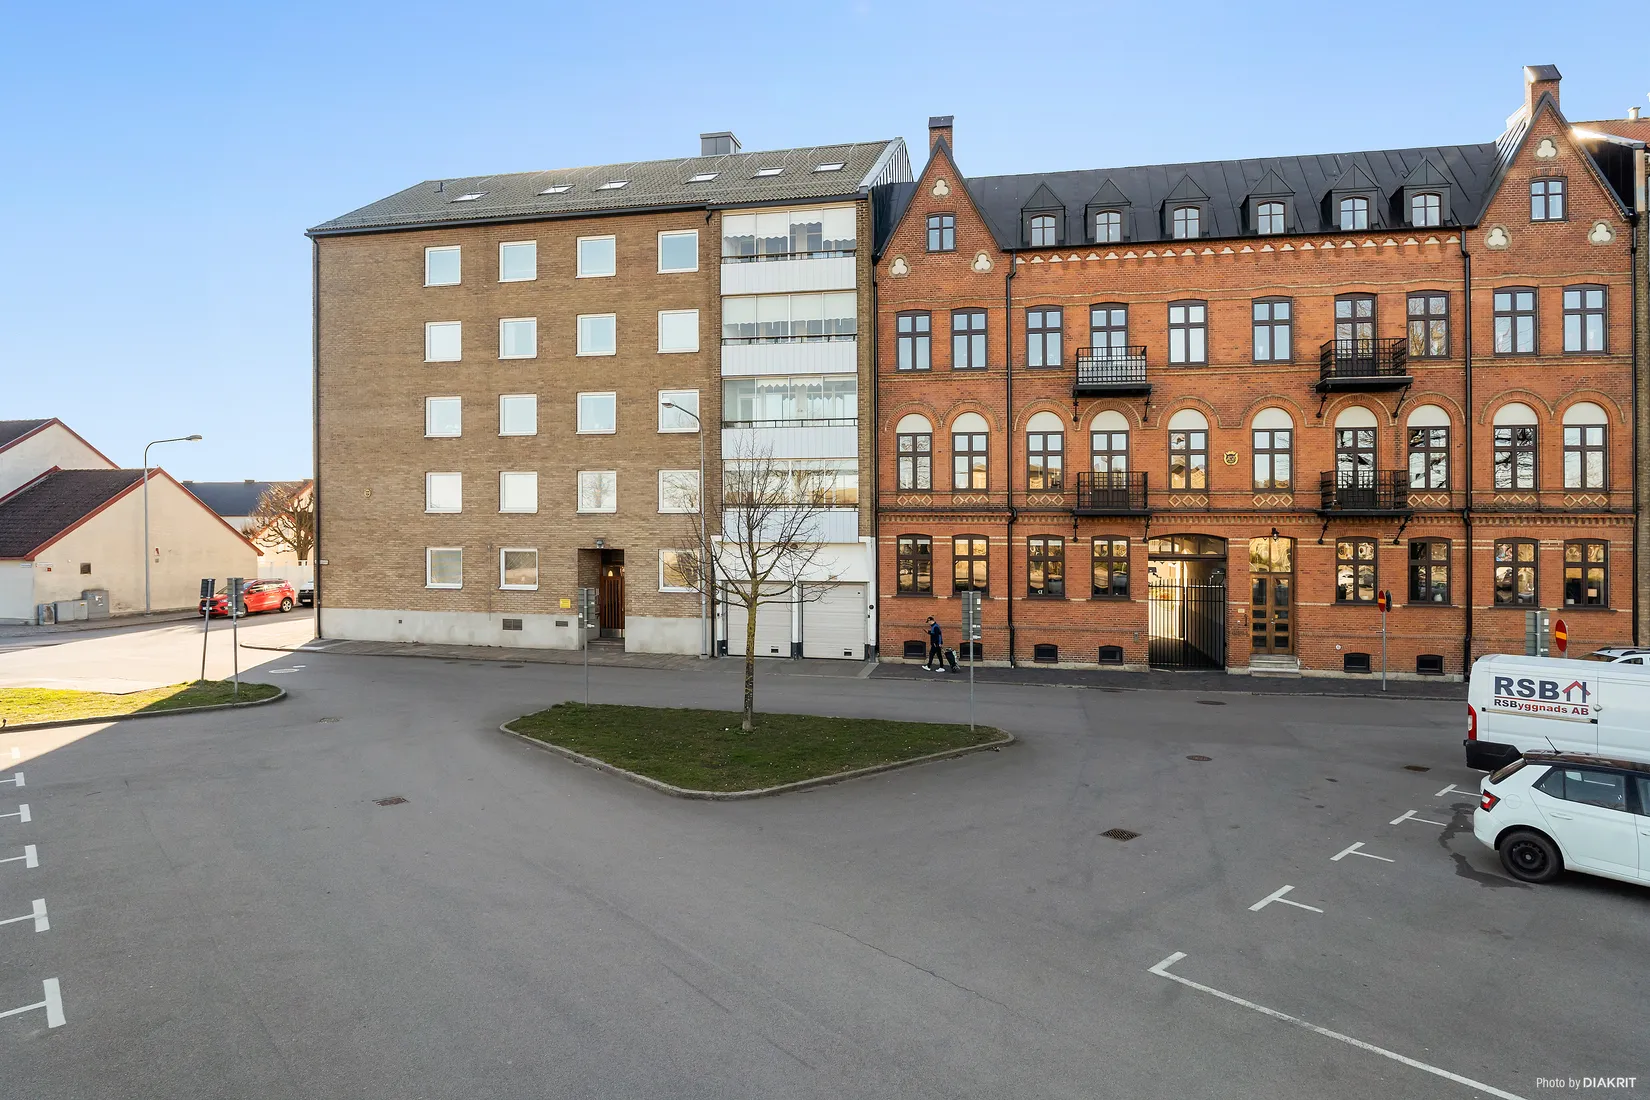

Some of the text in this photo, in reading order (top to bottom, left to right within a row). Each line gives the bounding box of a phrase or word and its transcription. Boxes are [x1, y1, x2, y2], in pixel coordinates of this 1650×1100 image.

[1494, 676, 1560, 700] RSB
[1494, 699, 1589, 716] RSByggnads AB
